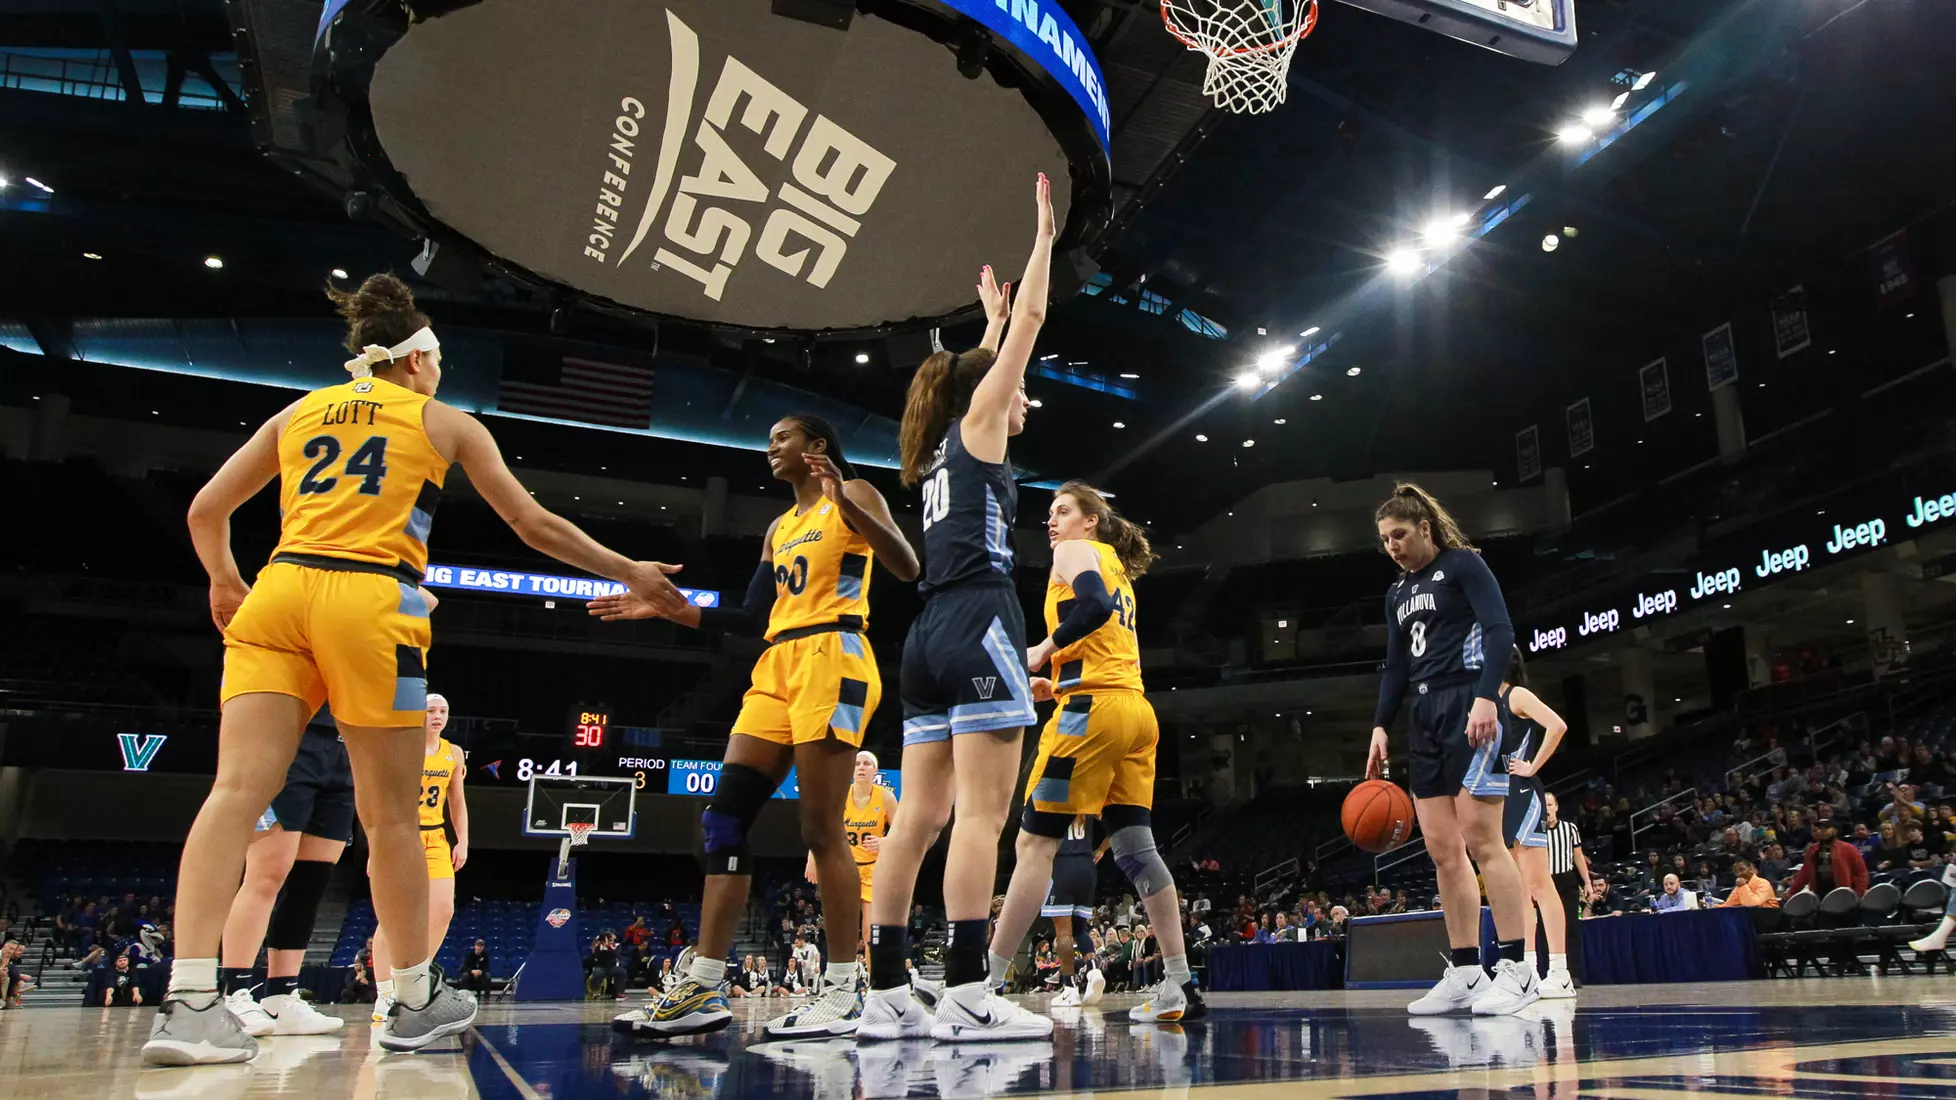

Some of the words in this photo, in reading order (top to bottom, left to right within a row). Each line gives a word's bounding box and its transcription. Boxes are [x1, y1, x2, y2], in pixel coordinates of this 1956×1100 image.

[584, 96, 645, 263] CONFERENCE
[653, 54, 809, 302] EAST
[755, 113, 898, 290] BIG
[321, 400, 384, 425] LOTT
[299, 434, 389, 496] 24
[922, 467, 950, 532] 20
[425, 566, 453, 584] IG
[459, 569, 524, 590] EAST
[1529, 626, 1567, 652] Jeep
[1579, 608, 1619, 636] Jeep
[1633, 589, 1677, 618] Jeep
[1691, 567, 1741, 599] Jeep
[1756, 544, 1809, 577] Jeep
[1826, 518, 1886, 554] Jeep
[1396, 593, 1437, 626] VILLANOVA
[580, 712, 608, 725] 8:41
[575, 725, 602, 746] 30
[117, 733, 168, 771] V
[618, 757, 666, 770] PERIOD
[517, 758, 578, 782] 8:41
[671, 760, 698, 770] TEAM
[700, 761, 724, 771] FOU
[634, 771, 647, 790] 3
[686, 772, 715, 793] 00
